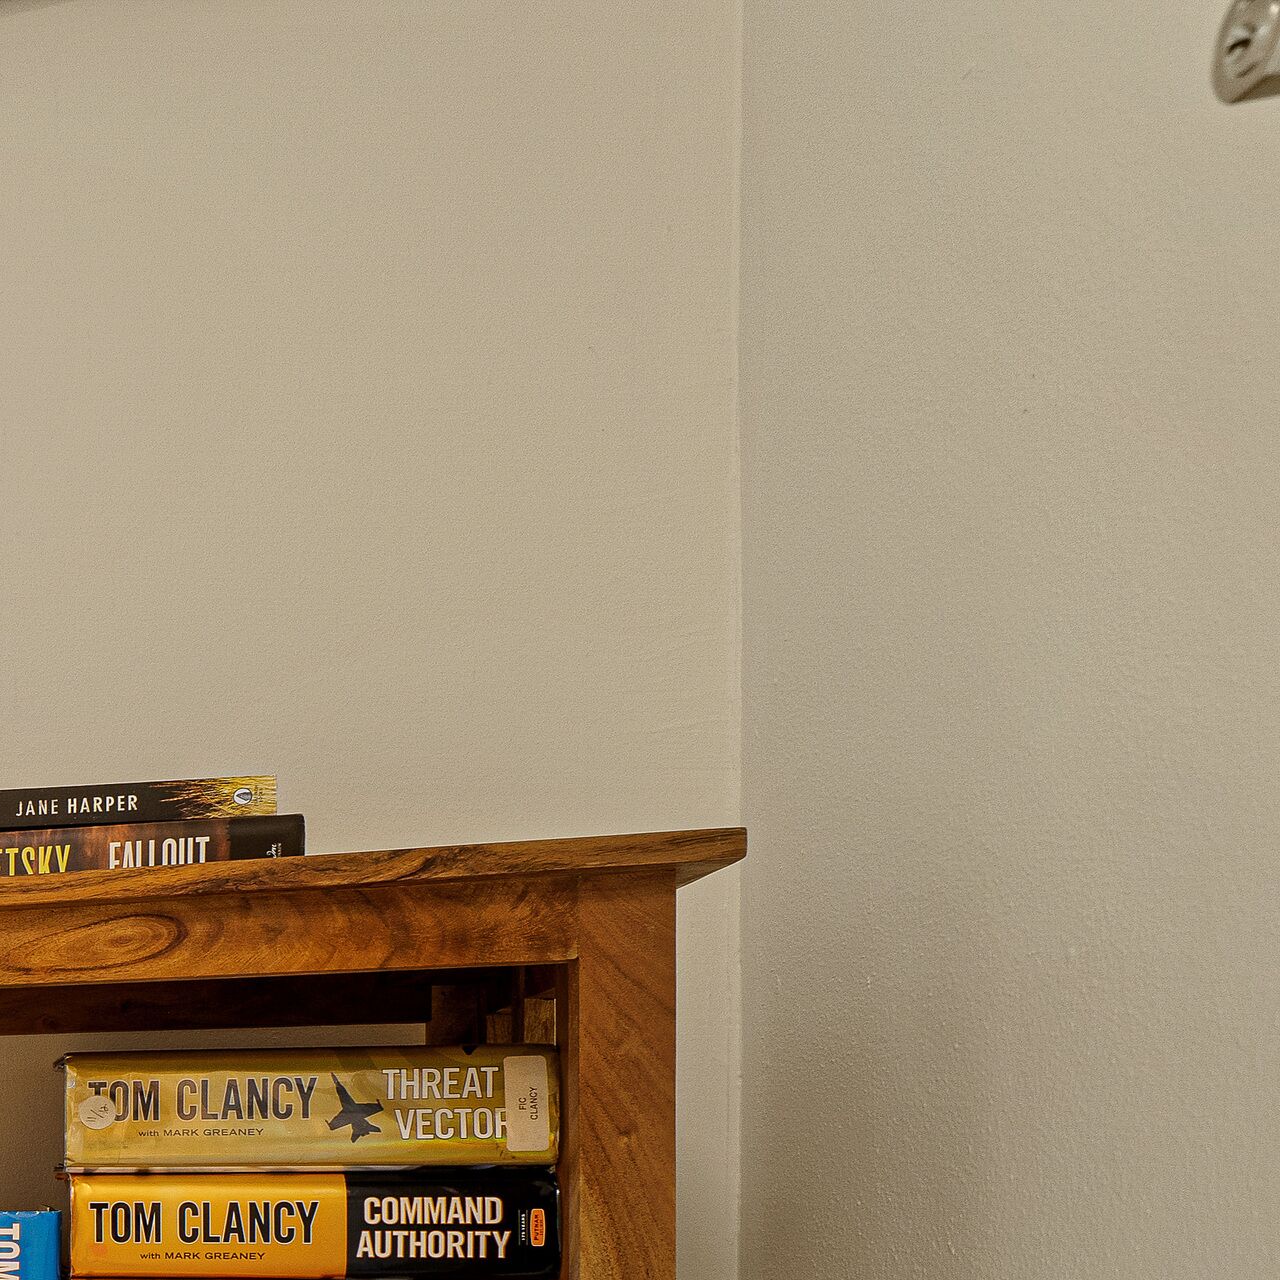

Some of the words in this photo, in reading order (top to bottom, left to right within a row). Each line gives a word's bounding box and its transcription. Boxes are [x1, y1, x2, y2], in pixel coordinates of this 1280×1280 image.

[16, 799, 58, 817] JANE
[67, 795, 138, 814] HARPER
[382, 1066, 499, 1099] THREAT
[176, 1076, 318, 1121] CLANCY
[204, 1128, 263, 1136] GREANEY
[90, 1201, 162, 1244] TOM
[178, 1201, 319, 1244] CLANCY
[364, 1197, 503, 1225] COMMAND
[139, 1252, 161, 1260] with
[165, 1251, 200, 1260] MARK
[205, 1251, 265, 1260] GREANEY
[356, 1230, 512, 1258] AUTHORITY
